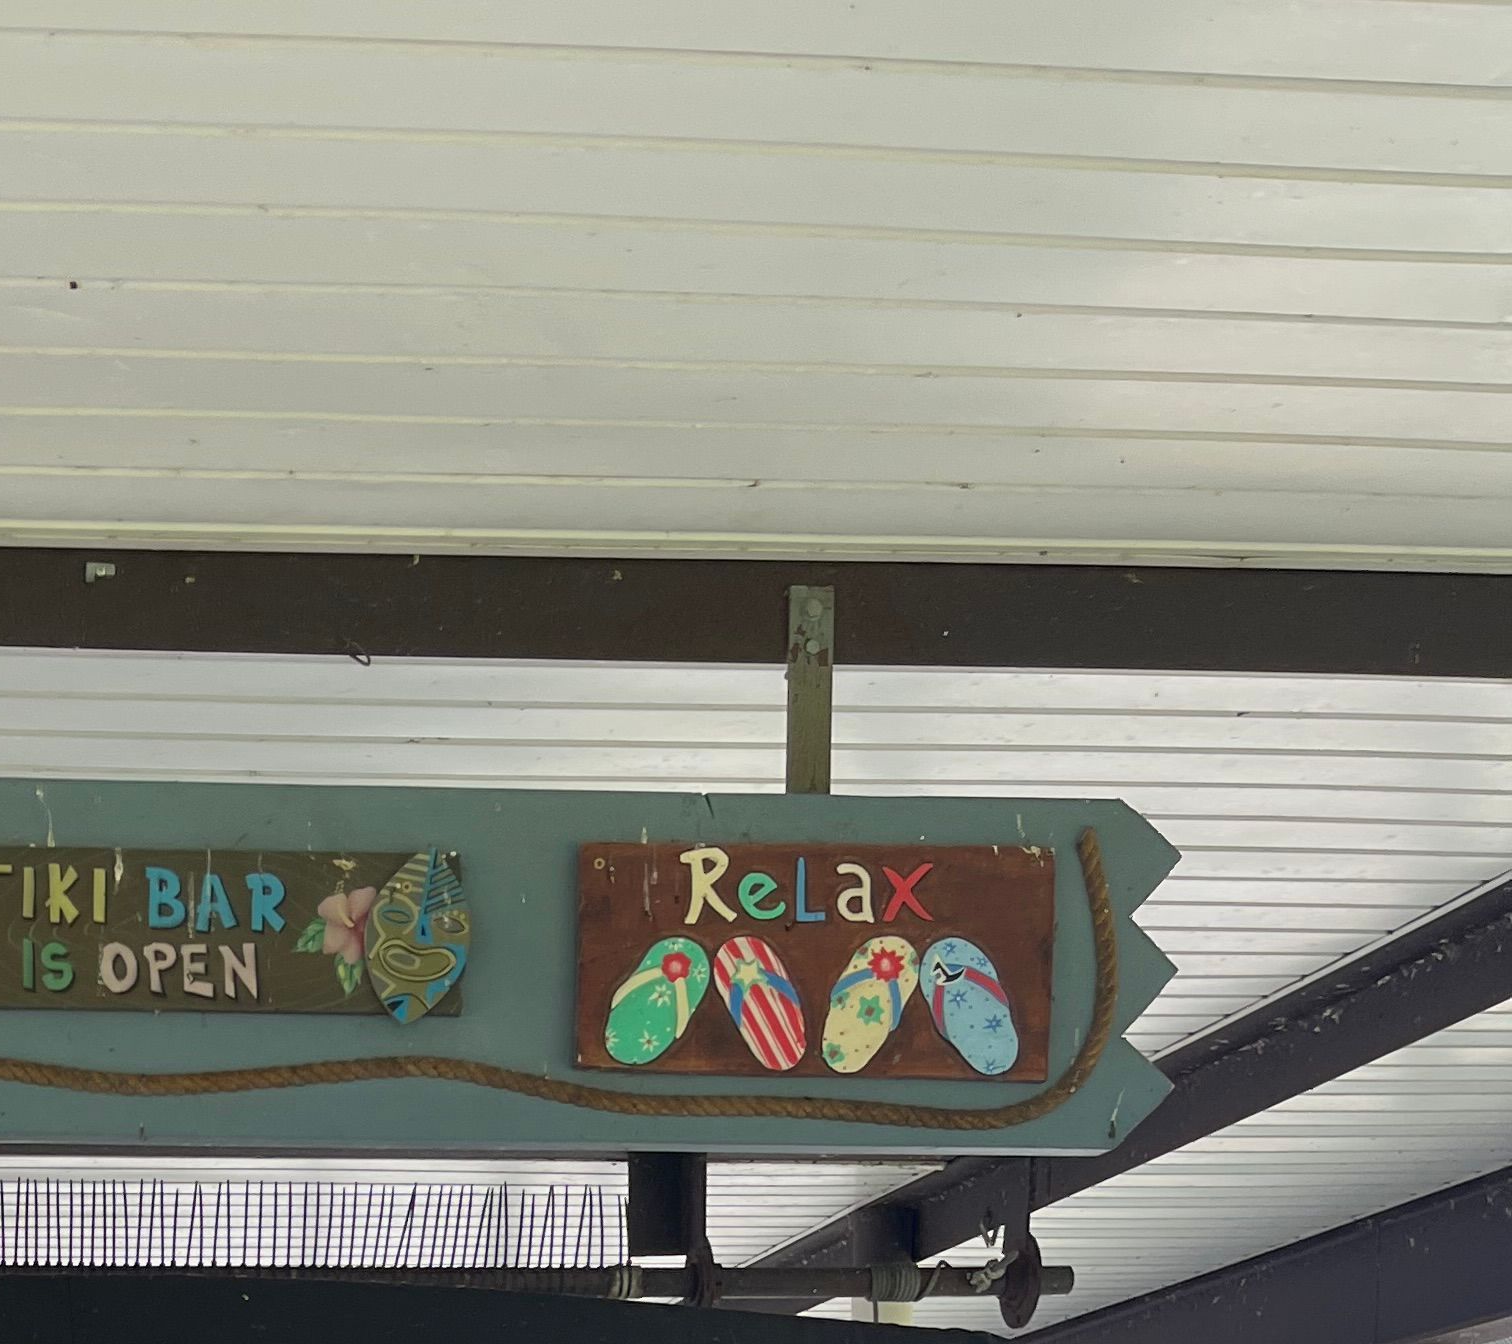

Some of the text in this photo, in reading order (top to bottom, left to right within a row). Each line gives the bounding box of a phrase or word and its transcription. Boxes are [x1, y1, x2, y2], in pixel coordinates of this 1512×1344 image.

[145, 867, 287, 934] BAR
[21, 937, 259, 1000] IS OPEN
